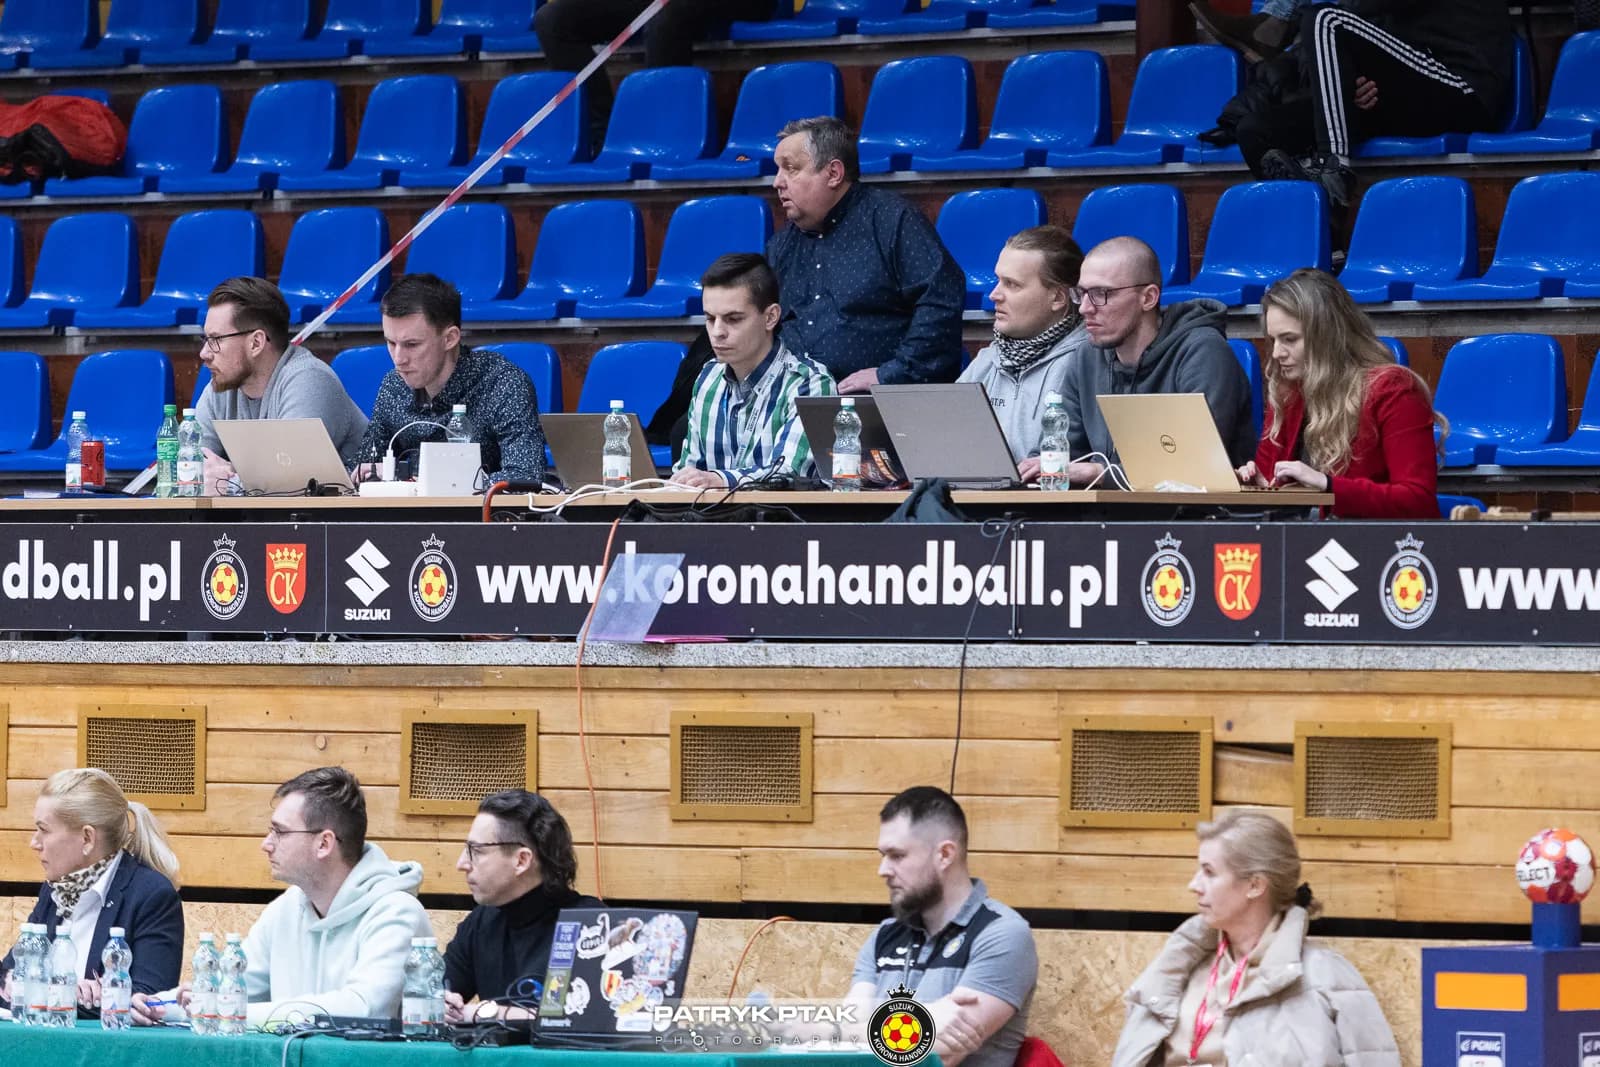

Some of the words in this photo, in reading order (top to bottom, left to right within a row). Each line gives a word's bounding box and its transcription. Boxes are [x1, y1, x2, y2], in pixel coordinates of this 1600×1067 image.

[2, 539, 181, 622] dball.pl
[269, 571, 298, 605] CK
[475, 540, 1119, 628] www.koronahandball.pl
[1218, 573, 1252, 611] CK
[1458, 567, 1600, 611] www
[344, 608, 391, 621] SUZUKI
[1303, 612, 1360, 628] SUZUKI
